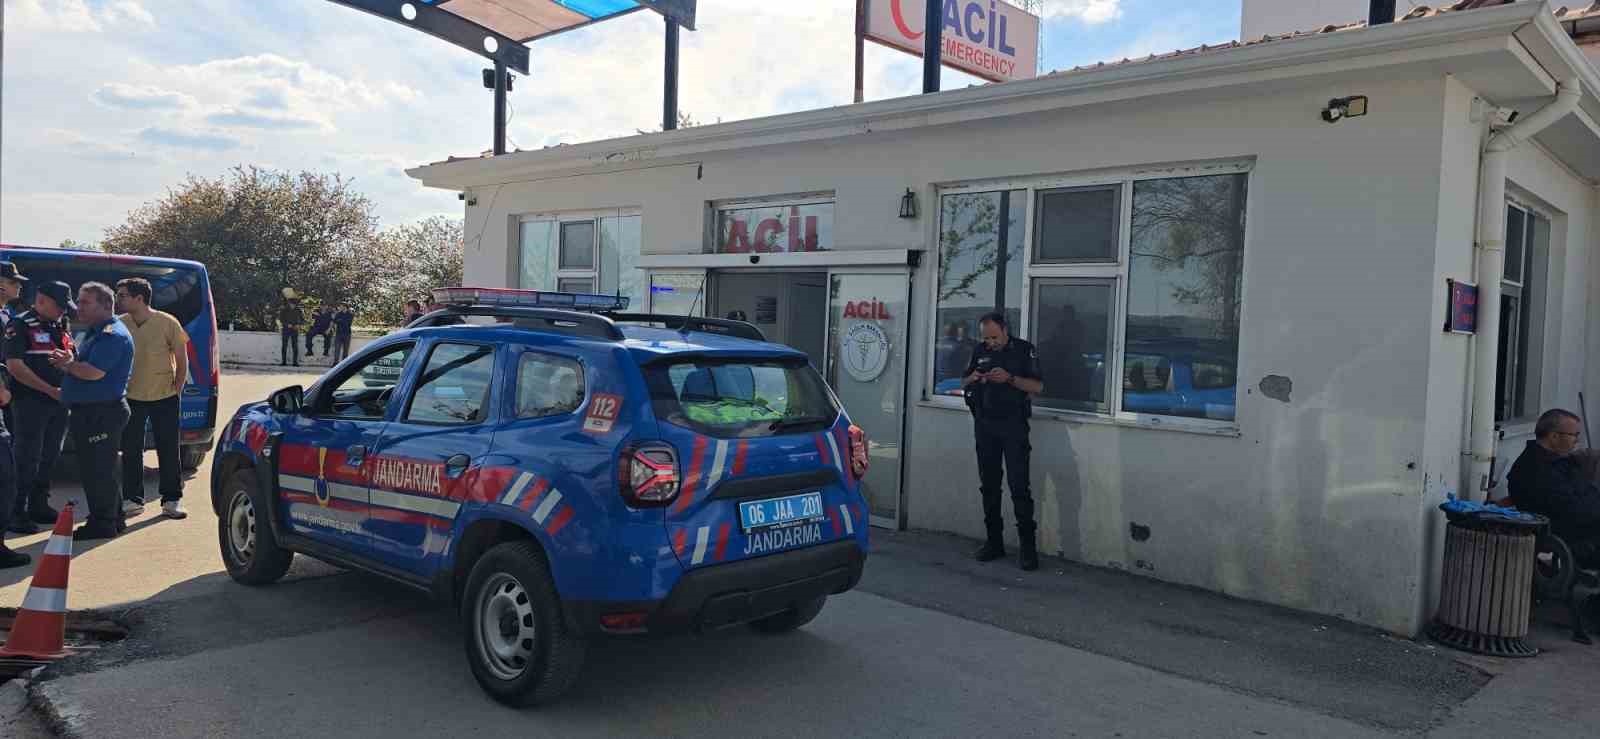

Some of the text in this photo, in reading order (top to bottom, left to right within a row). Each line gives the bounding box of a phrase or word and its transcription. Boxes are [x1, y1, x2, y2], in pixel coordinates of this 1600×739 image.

[943, 0, 1015, 57] ACİL
[843, 297, 889, 320] ACİL
[592, 398, 617, 417] 112
[372, 459, 441, 494] JANDARMA
[748, 495, 823, 524] 06 JAA 201
[743, 524, 822, 555] JANDARMA
